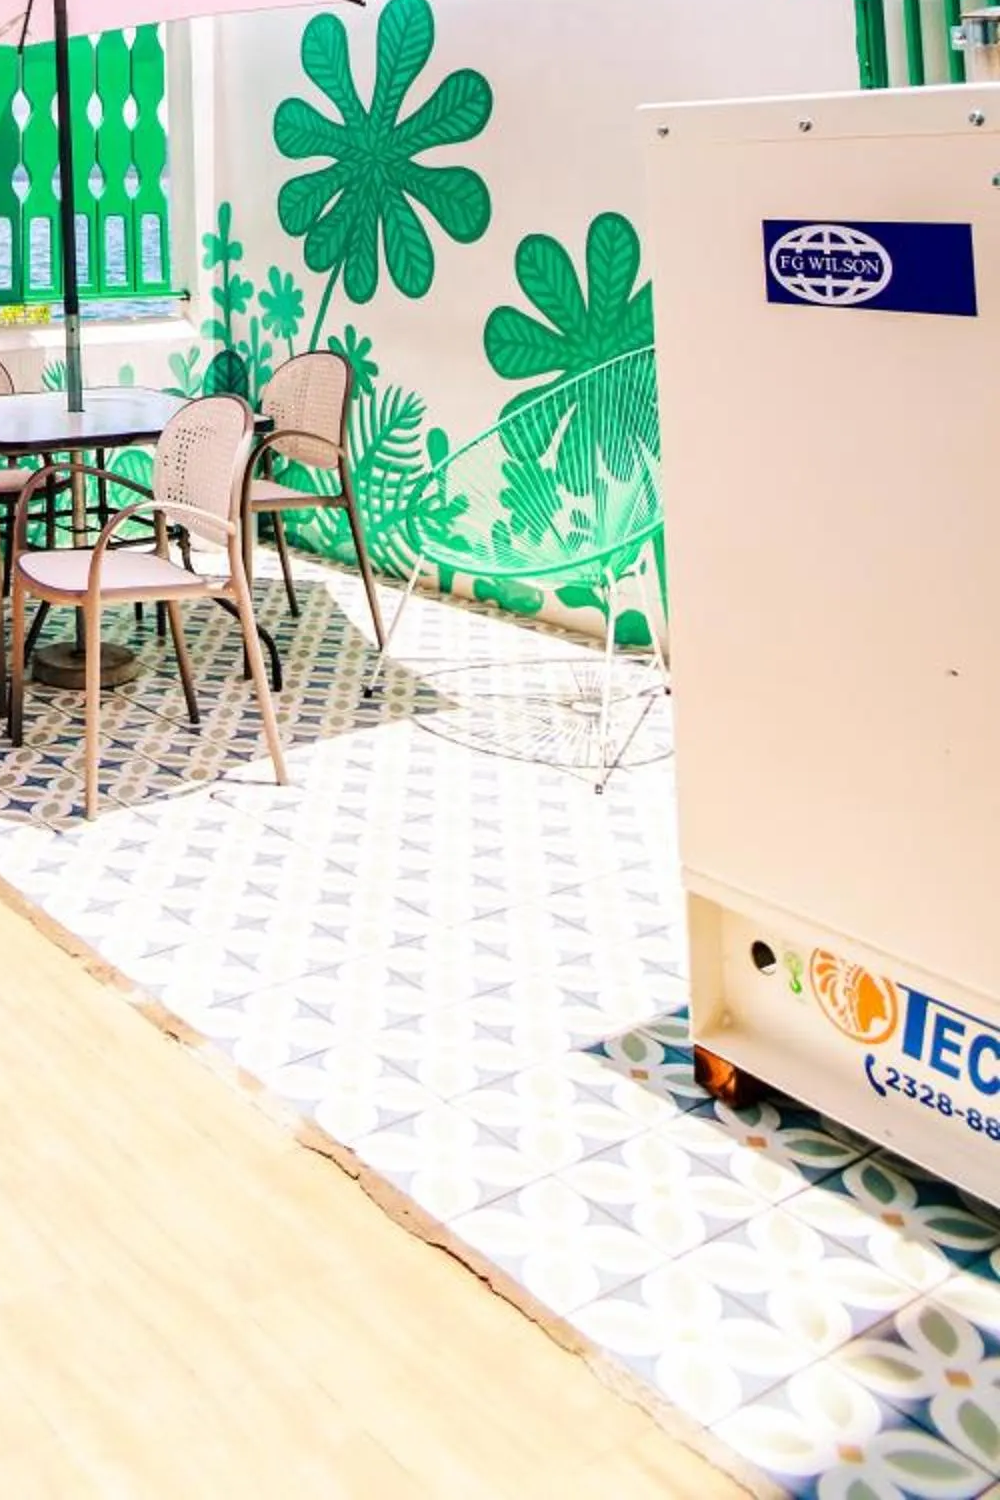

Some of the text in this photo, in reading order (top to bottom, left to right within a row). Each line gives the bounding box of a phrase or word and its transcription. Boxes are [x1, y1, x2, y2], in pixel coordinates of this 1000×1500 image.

[780, 255, 881, 275] FG WILSON
[896, 982, 1000, 1096] TEC
[885, 1066, 1000, 1142] 2328-88
